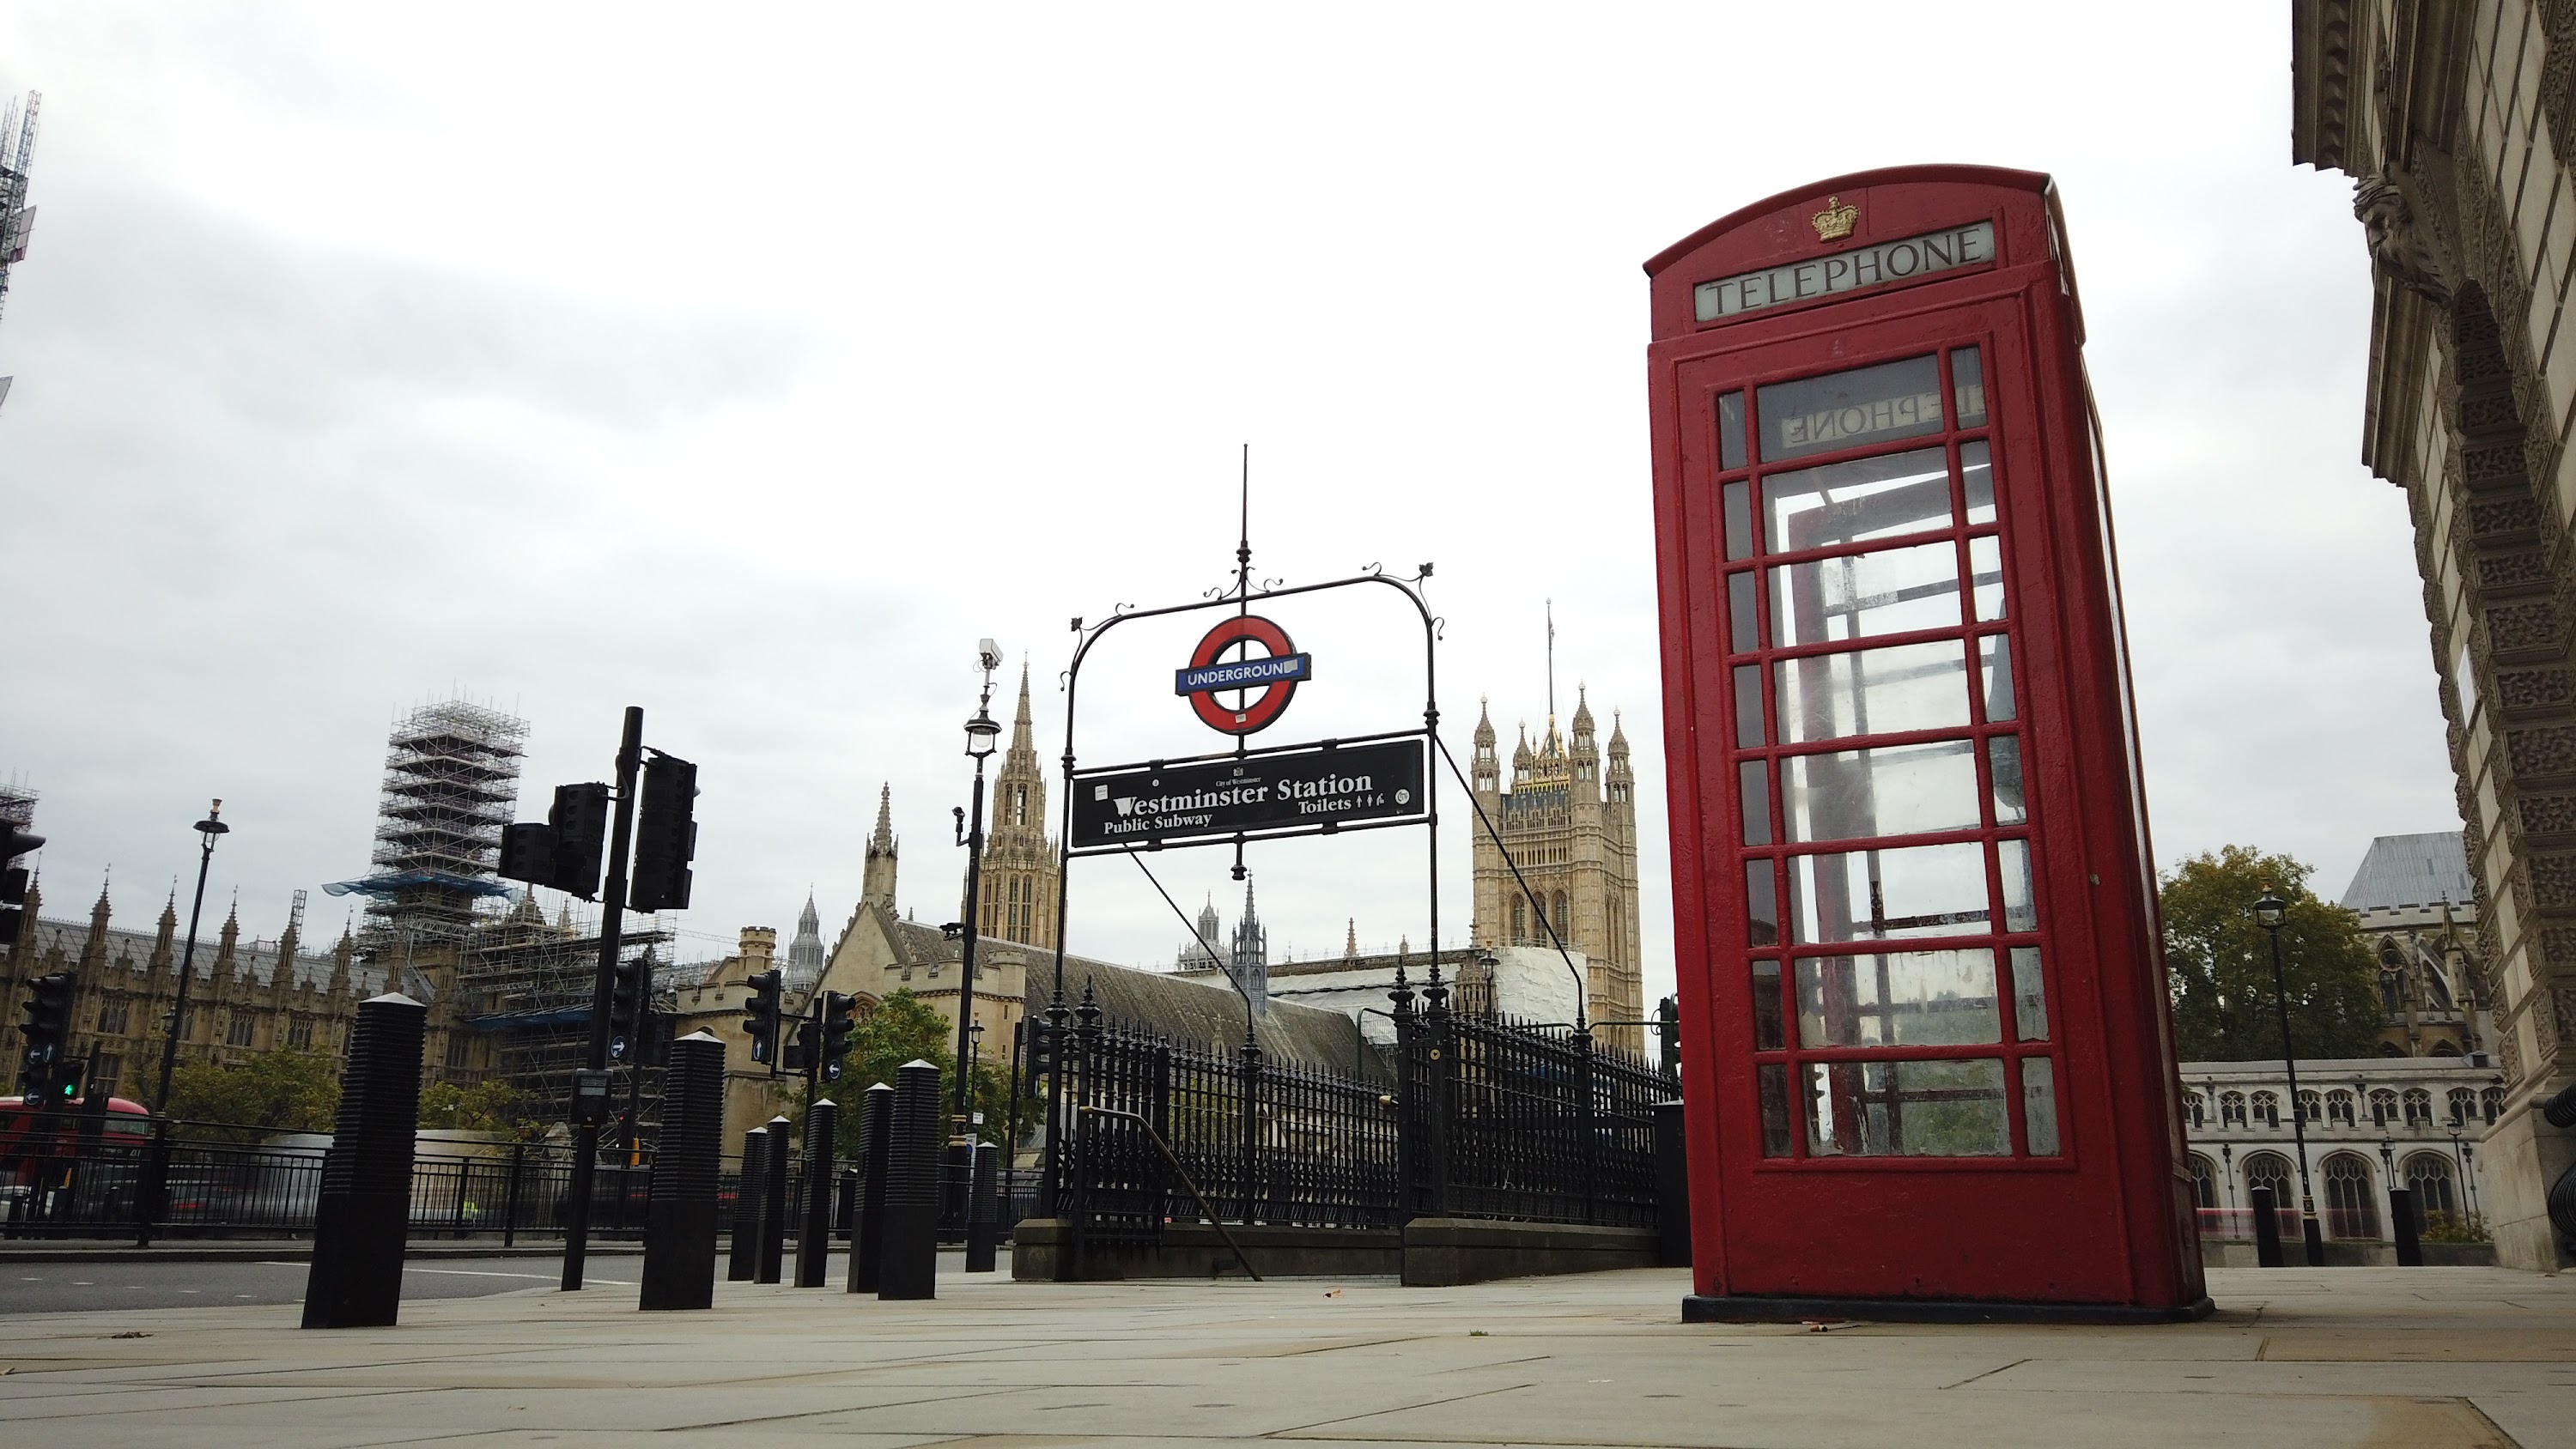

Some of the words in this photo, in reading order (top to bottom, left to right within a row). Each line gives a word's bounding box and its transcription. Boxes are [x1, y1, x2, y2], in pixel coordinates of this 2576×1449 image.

[1705, 228, 1982, 314] TELEPHONE
[1113, 785, 1268, 817] Westminster
[1277, 773, 1373, 800] Station
[1298, 798, 1352, 815] Toilets
[1103, 818, 1151, 834] Public
[1154, 814, 1212, 829] Subway
